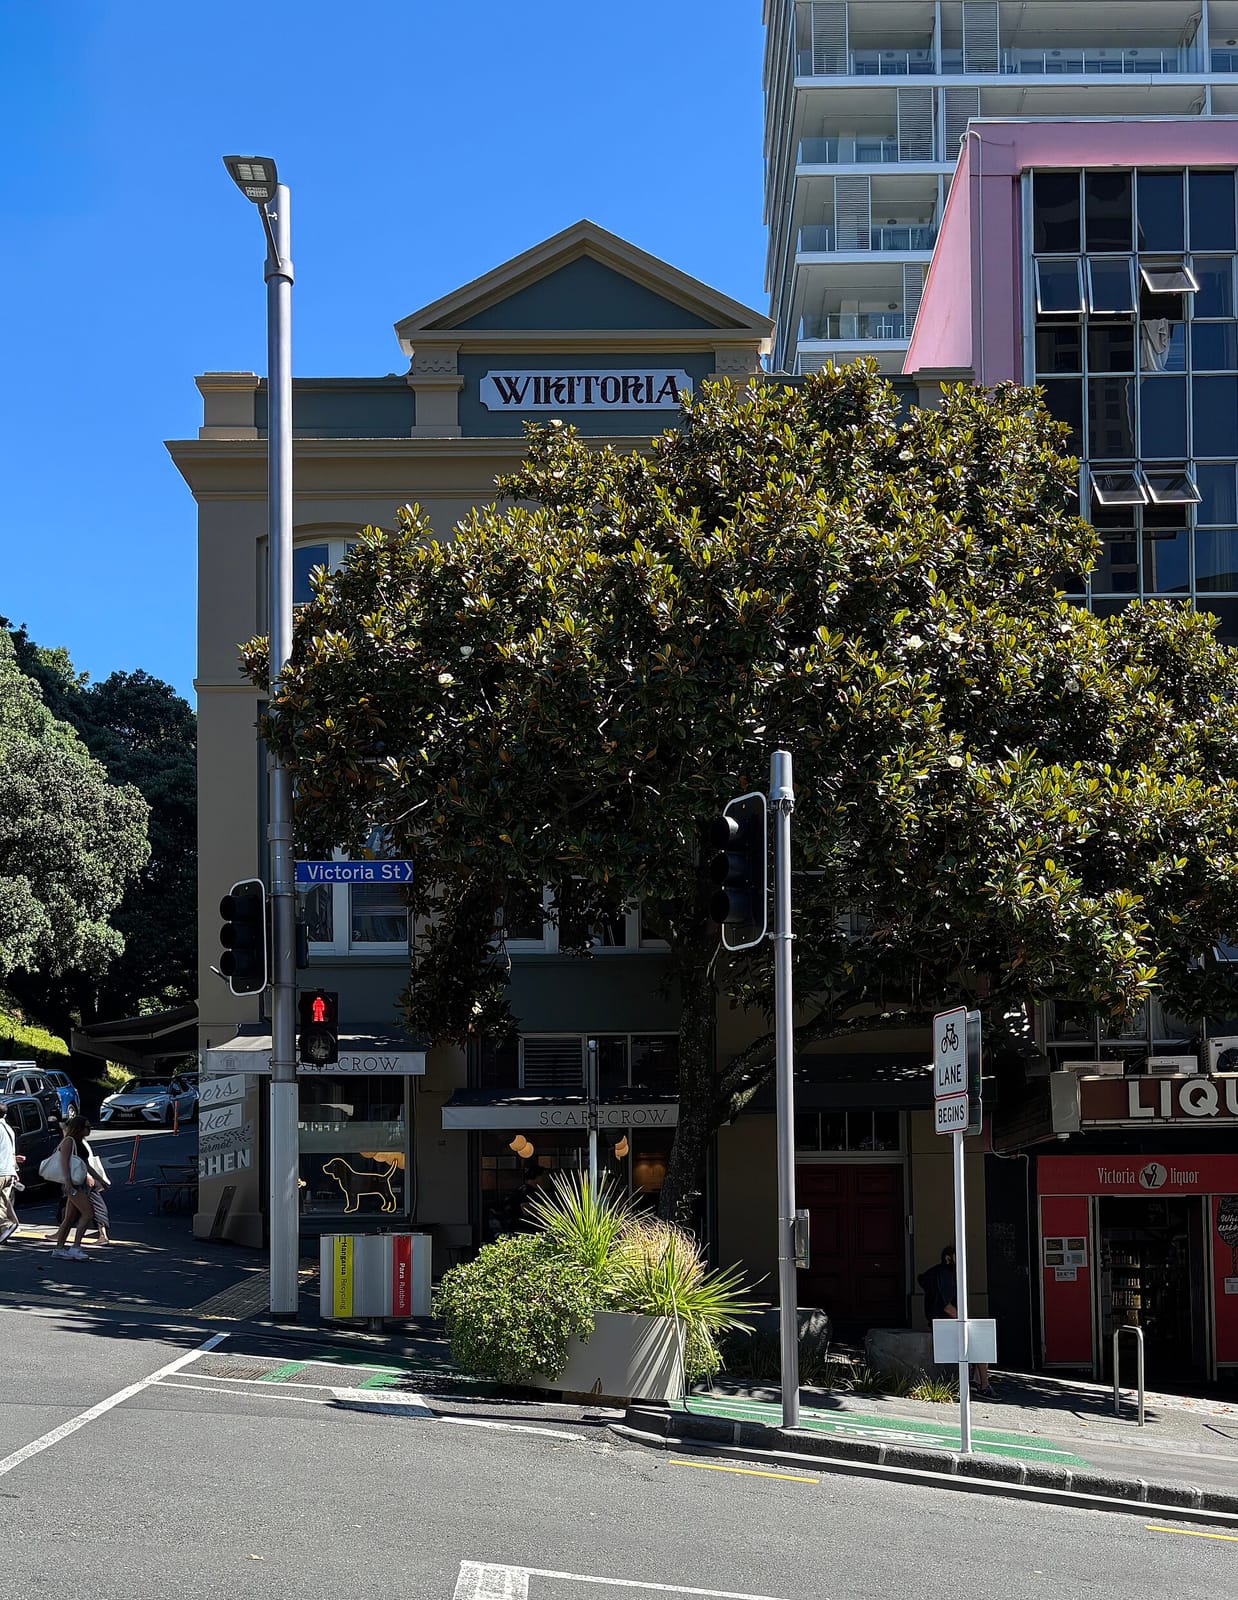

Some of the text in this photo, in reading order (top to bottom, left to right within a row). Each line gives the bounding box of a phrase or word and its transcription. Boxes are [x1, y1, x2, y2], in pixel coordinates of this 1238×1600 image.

[491, 375, 681, 405] WIKITORIA
[307, 864, 401, 880] Victoria St
[938, 1064, 962, 1087] LANE
[938, 1104, 965, 1124] BEGINS
[1098, 1167, 1135, 1184] Victoria
[1170, 1167, 1199, 1186] liquor
[339, 1278, 348, 1310] Recycling
